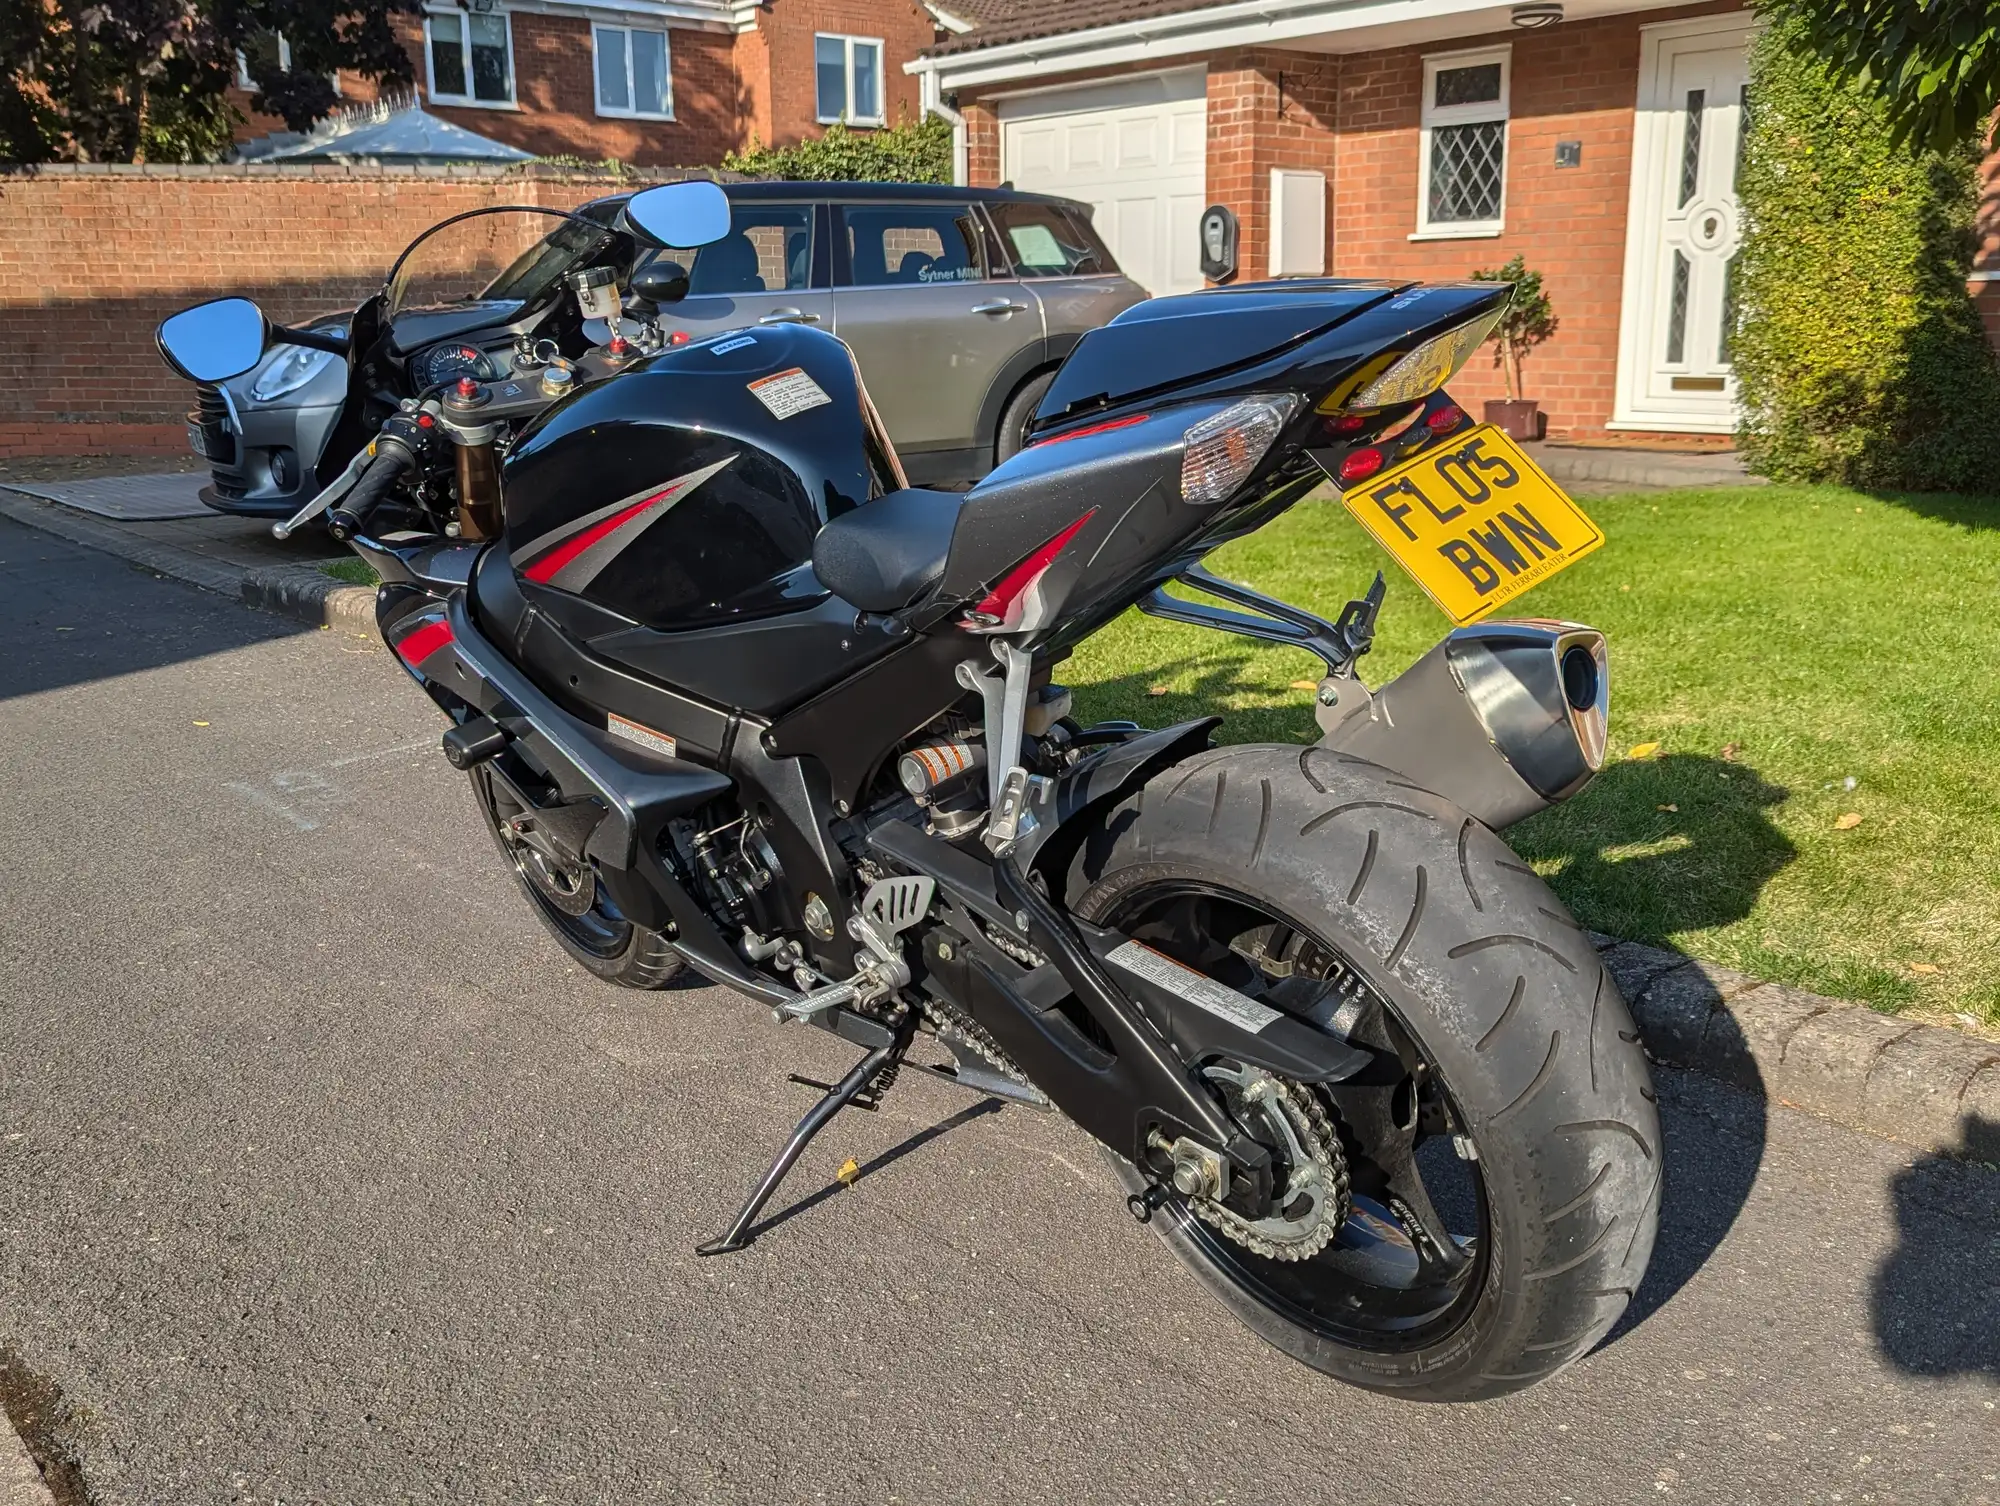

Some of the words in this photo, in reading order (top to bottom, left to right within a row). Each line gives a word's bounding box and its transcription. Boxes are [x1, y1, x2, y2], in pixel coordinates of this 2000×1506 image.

[918, 269, 954, 283] Sytner
[714, 338, 753, 353] UNLEADED
[1369, 436, 1520, 542] FL05
[1436, 502, 1564, 597] BWN
[1496, 585, 1514, 600] LTR
[1511, 566, 1544, 590] FERRARI
[1541, 553, 1568, 571] EATER
